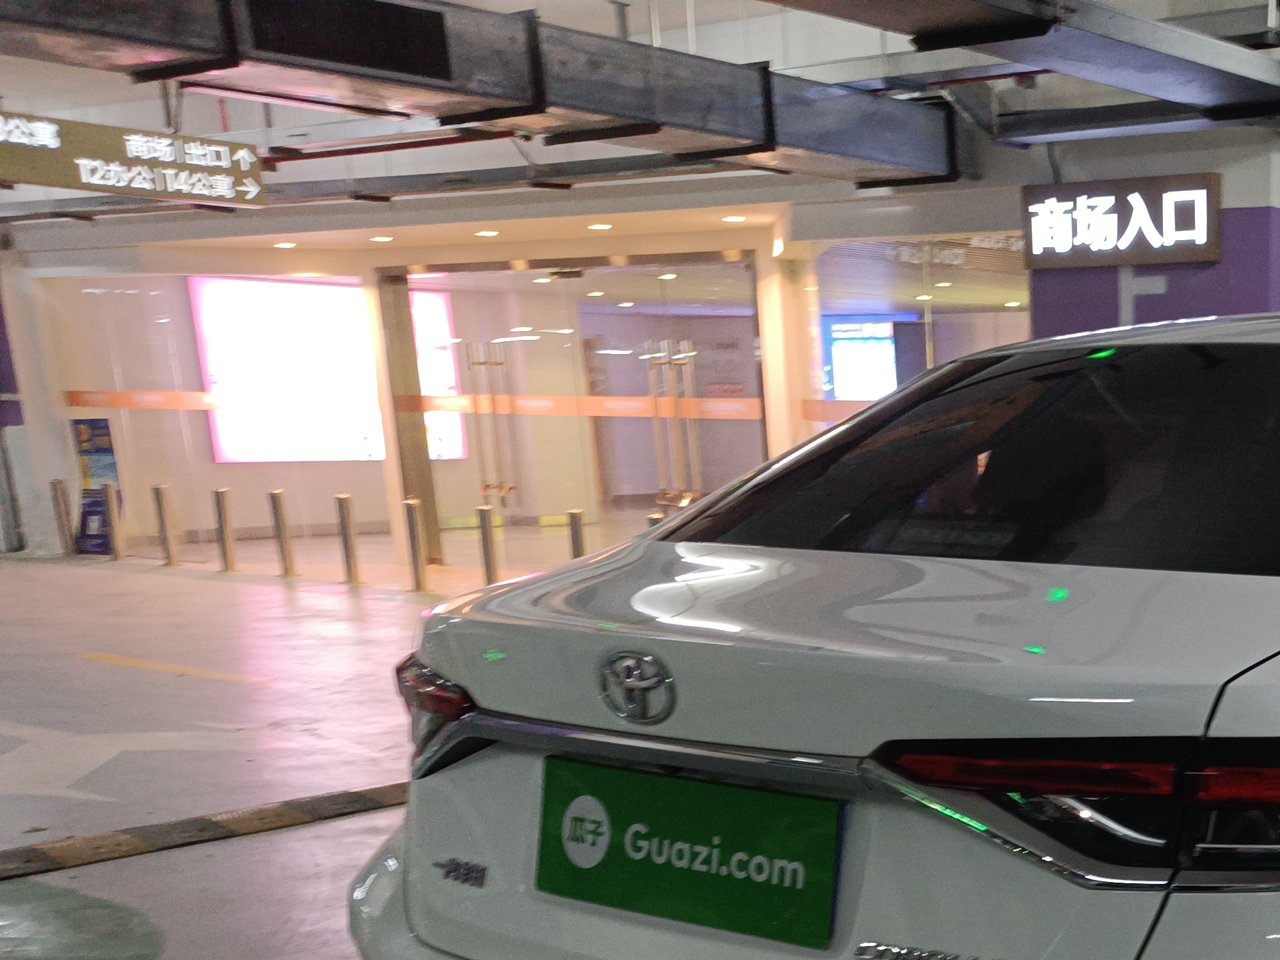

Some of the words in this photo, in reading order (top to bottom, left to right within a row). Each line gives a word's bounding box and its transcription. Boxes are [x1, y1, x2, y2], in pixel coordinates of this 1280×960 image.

[1028, 188, 1208, 255] 商场入口
[624, 823, 806, 890] Guazi.com
